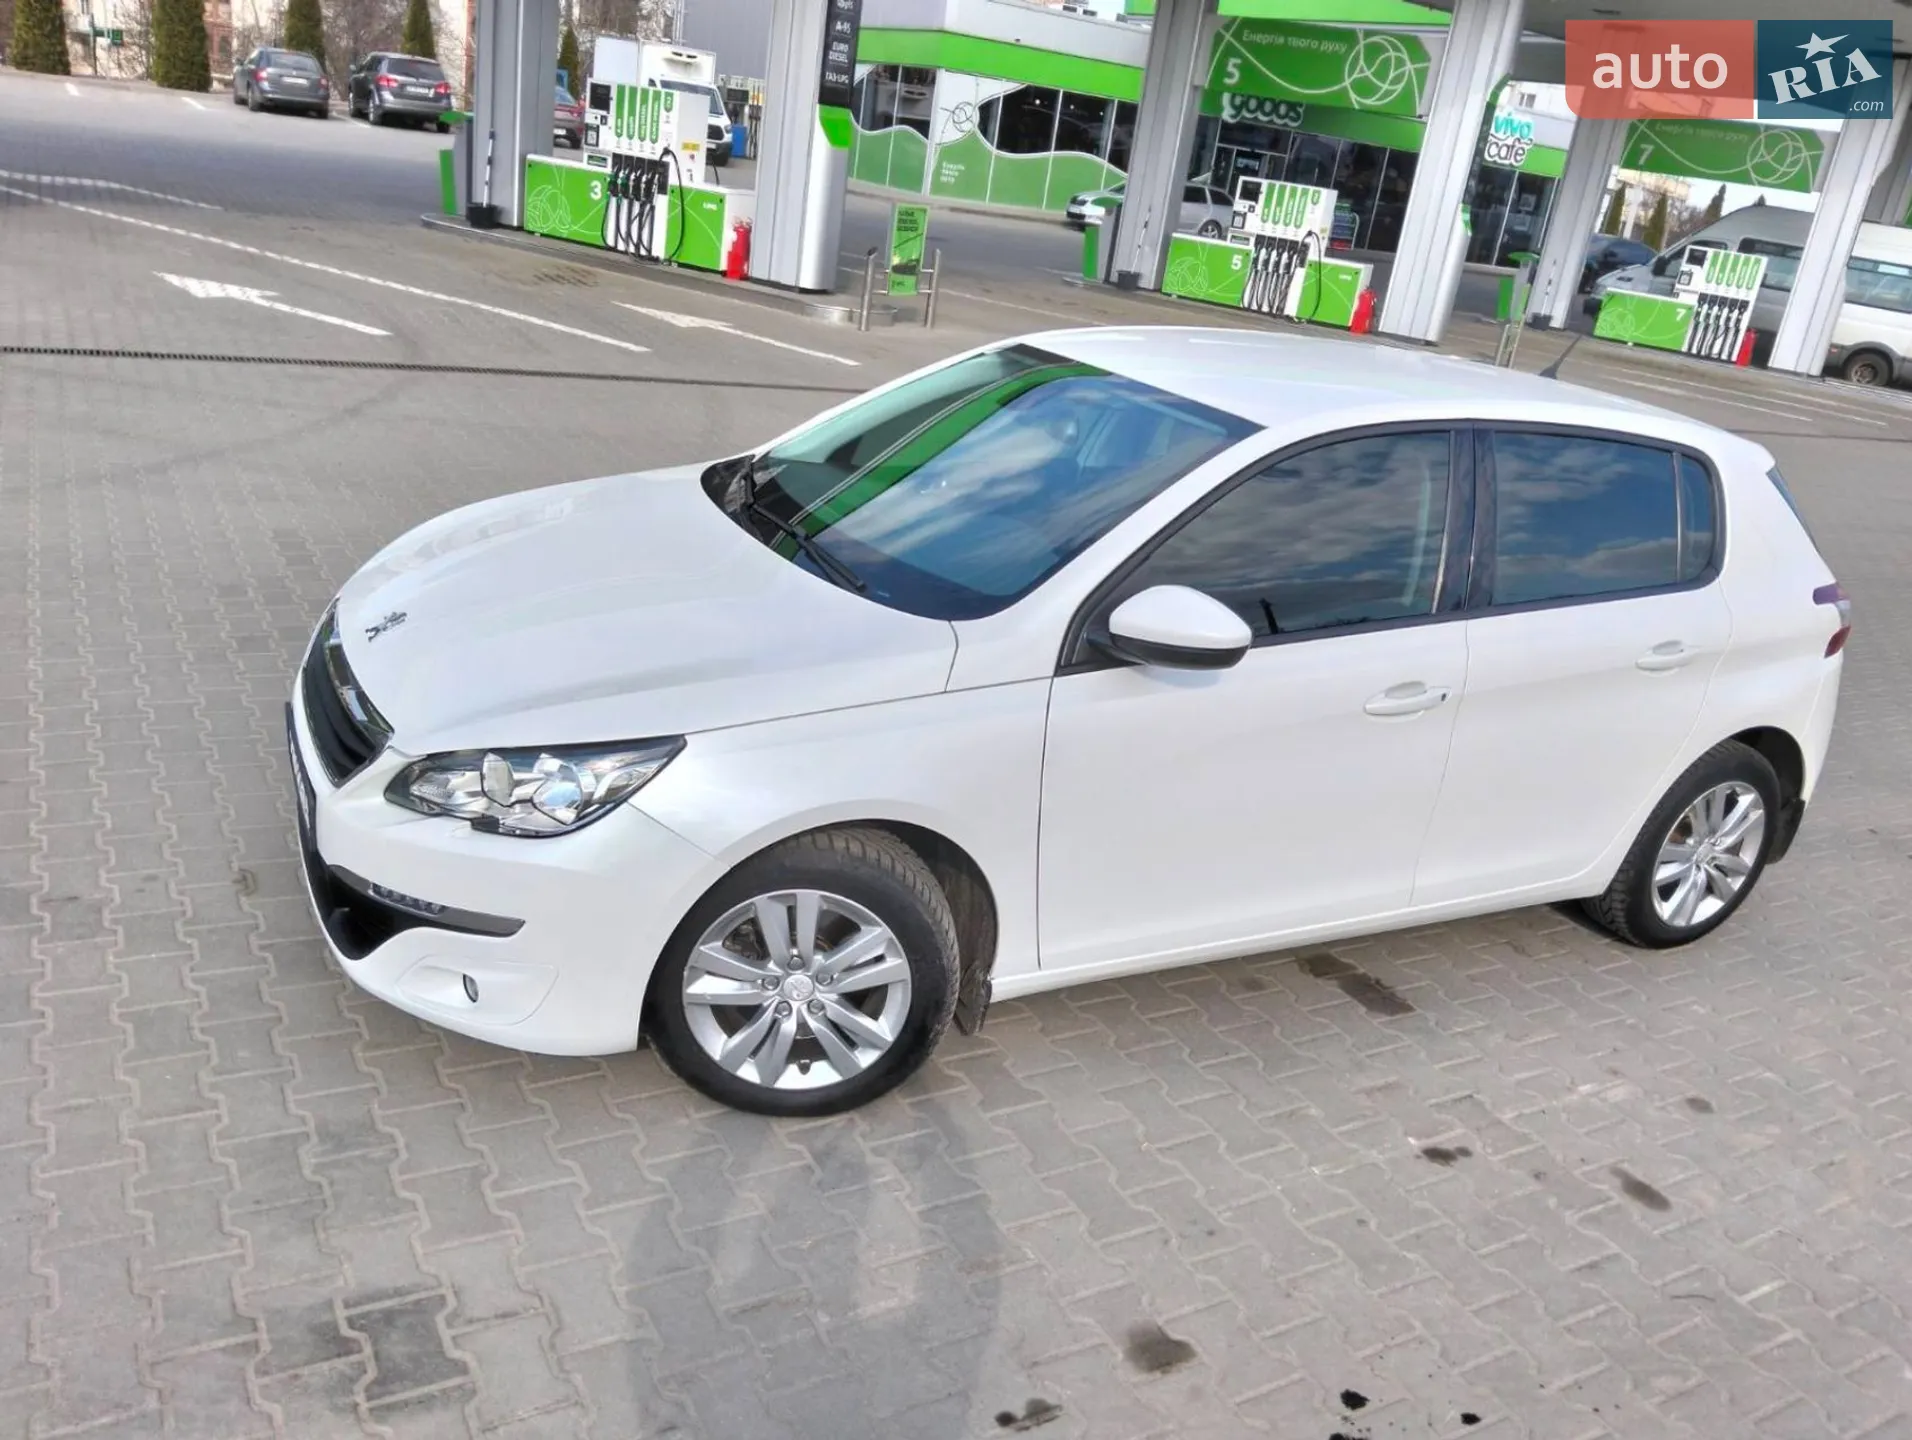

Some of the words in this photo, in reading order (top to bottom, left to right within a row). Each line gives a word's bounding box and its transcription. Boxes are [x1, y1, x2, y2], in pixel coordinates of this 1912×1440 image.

[1242, 29, 1285, 46] Енергія
[1287, 35, 1320, 49] твого
[1320, 41, 1348, 54] руху
[1223, 58, 1242, 85] 5
[1638, 143, 1655, 165] 7
[590, 180, 602, 200] 3
[1231, 254, 1243, 270] 5
[1676, 308, 1687, 321] 7
